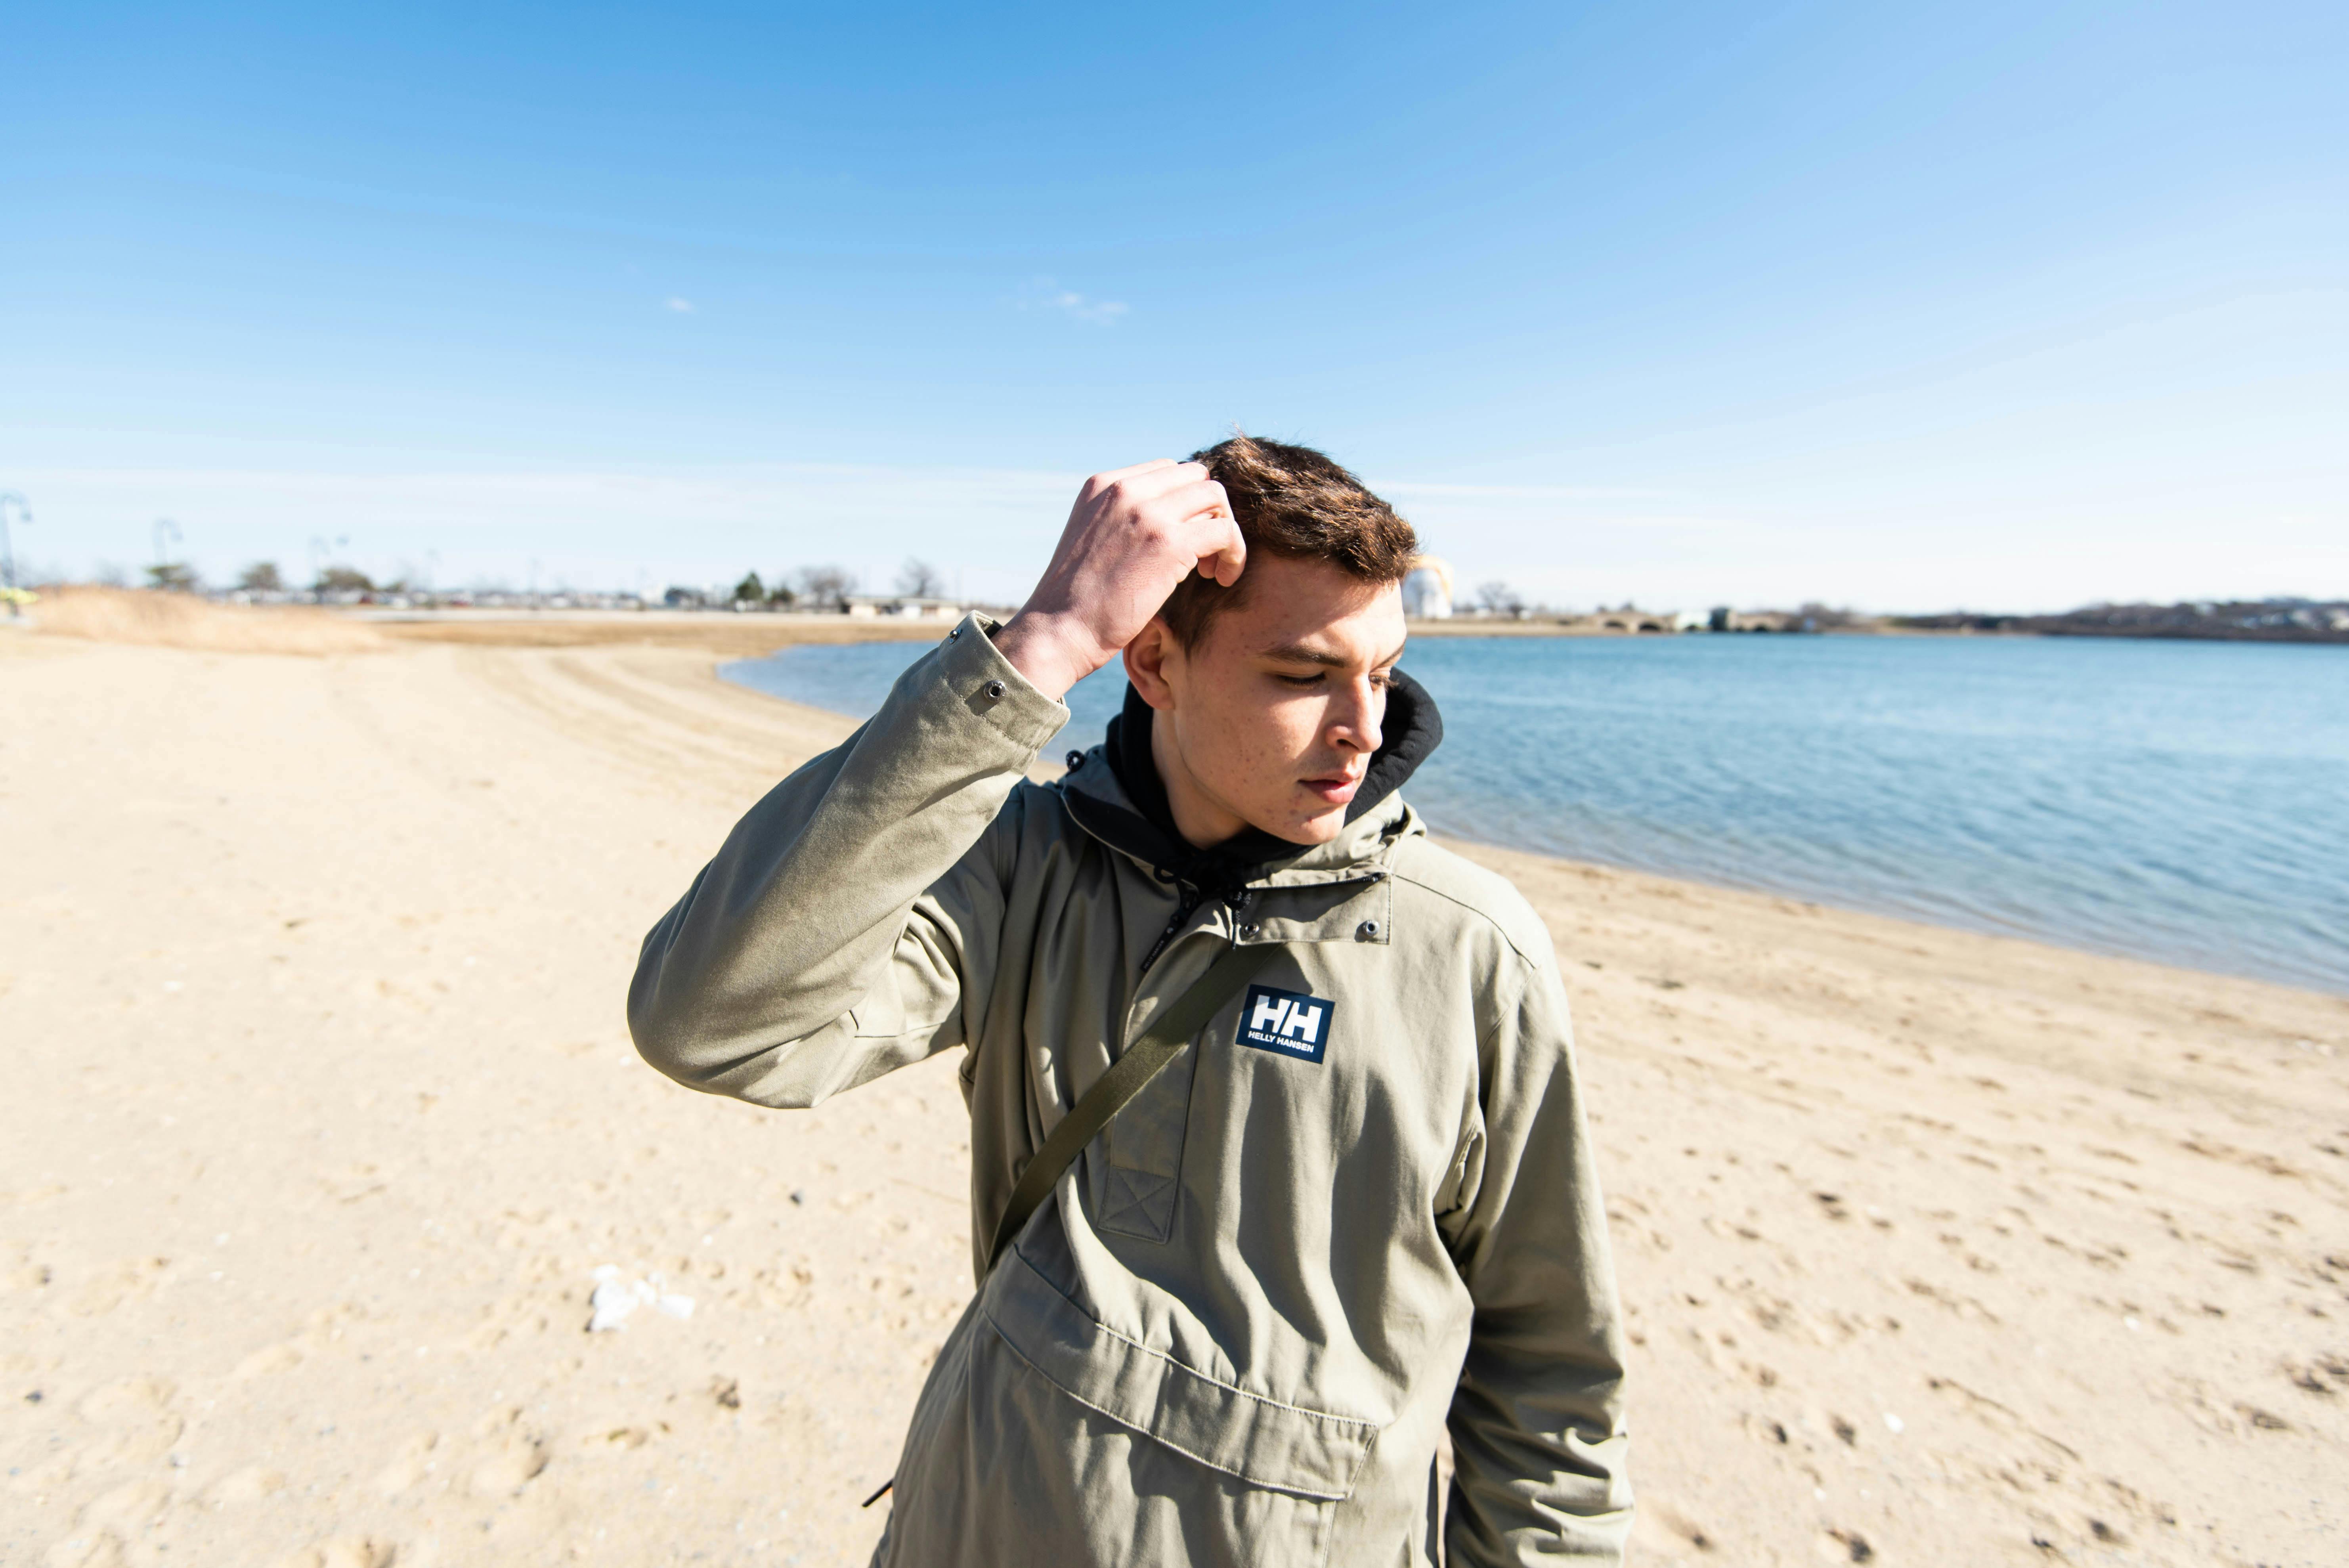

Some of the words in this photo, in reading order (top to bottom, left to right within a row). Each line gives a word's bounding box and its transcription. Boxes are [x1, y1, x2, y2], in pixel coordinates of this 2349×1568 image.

[1250, 995, 1322, 1043] HH
[1248, 1031, 1276, 1043] HELLY
[1277, 1037, 1314, 1053] HANSEN
